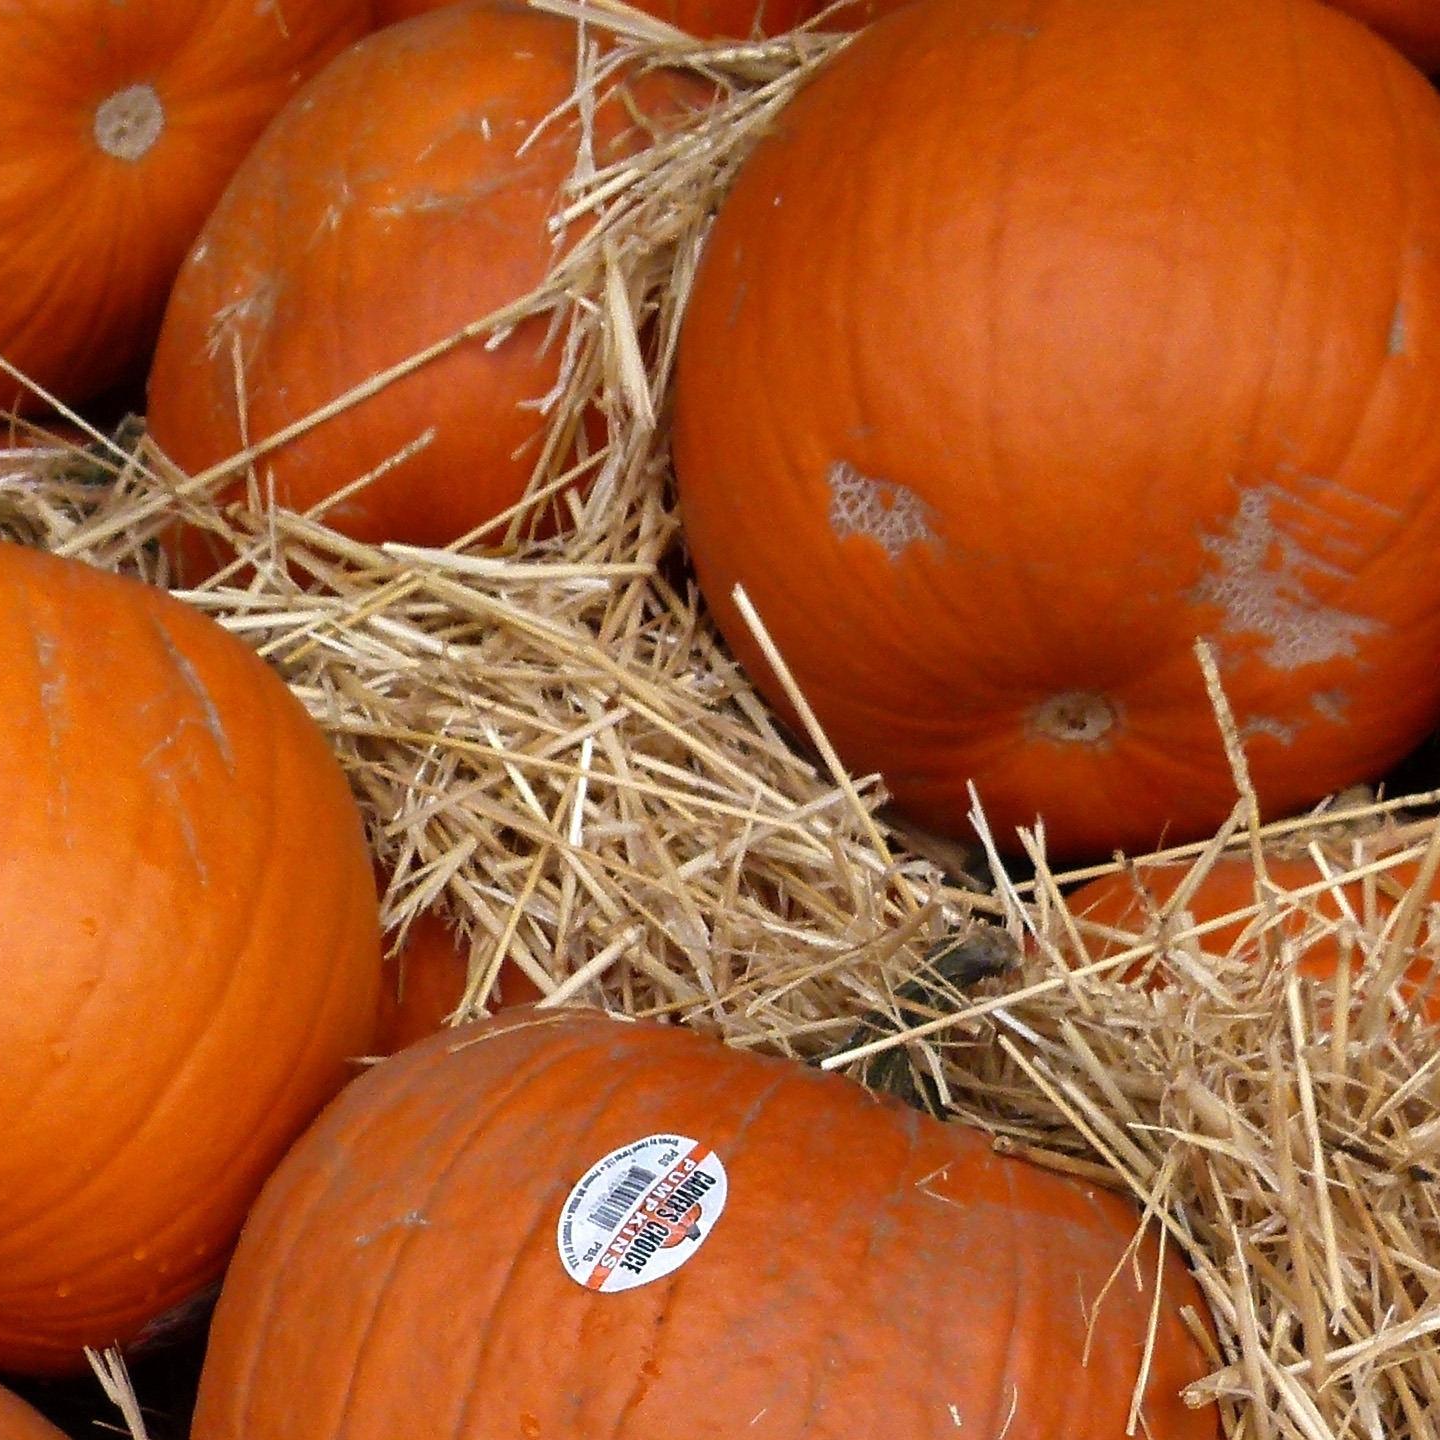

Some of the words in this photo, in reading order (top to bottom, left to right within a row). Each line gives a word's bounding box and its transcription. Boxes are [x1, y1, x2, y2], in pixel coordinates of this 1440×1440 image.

[601, 1157, 697, 1269] PUMPKINS
[656, 1170, 717, 1223] CARVER'S
[619, 1221, 670, 1275] CHOICE
